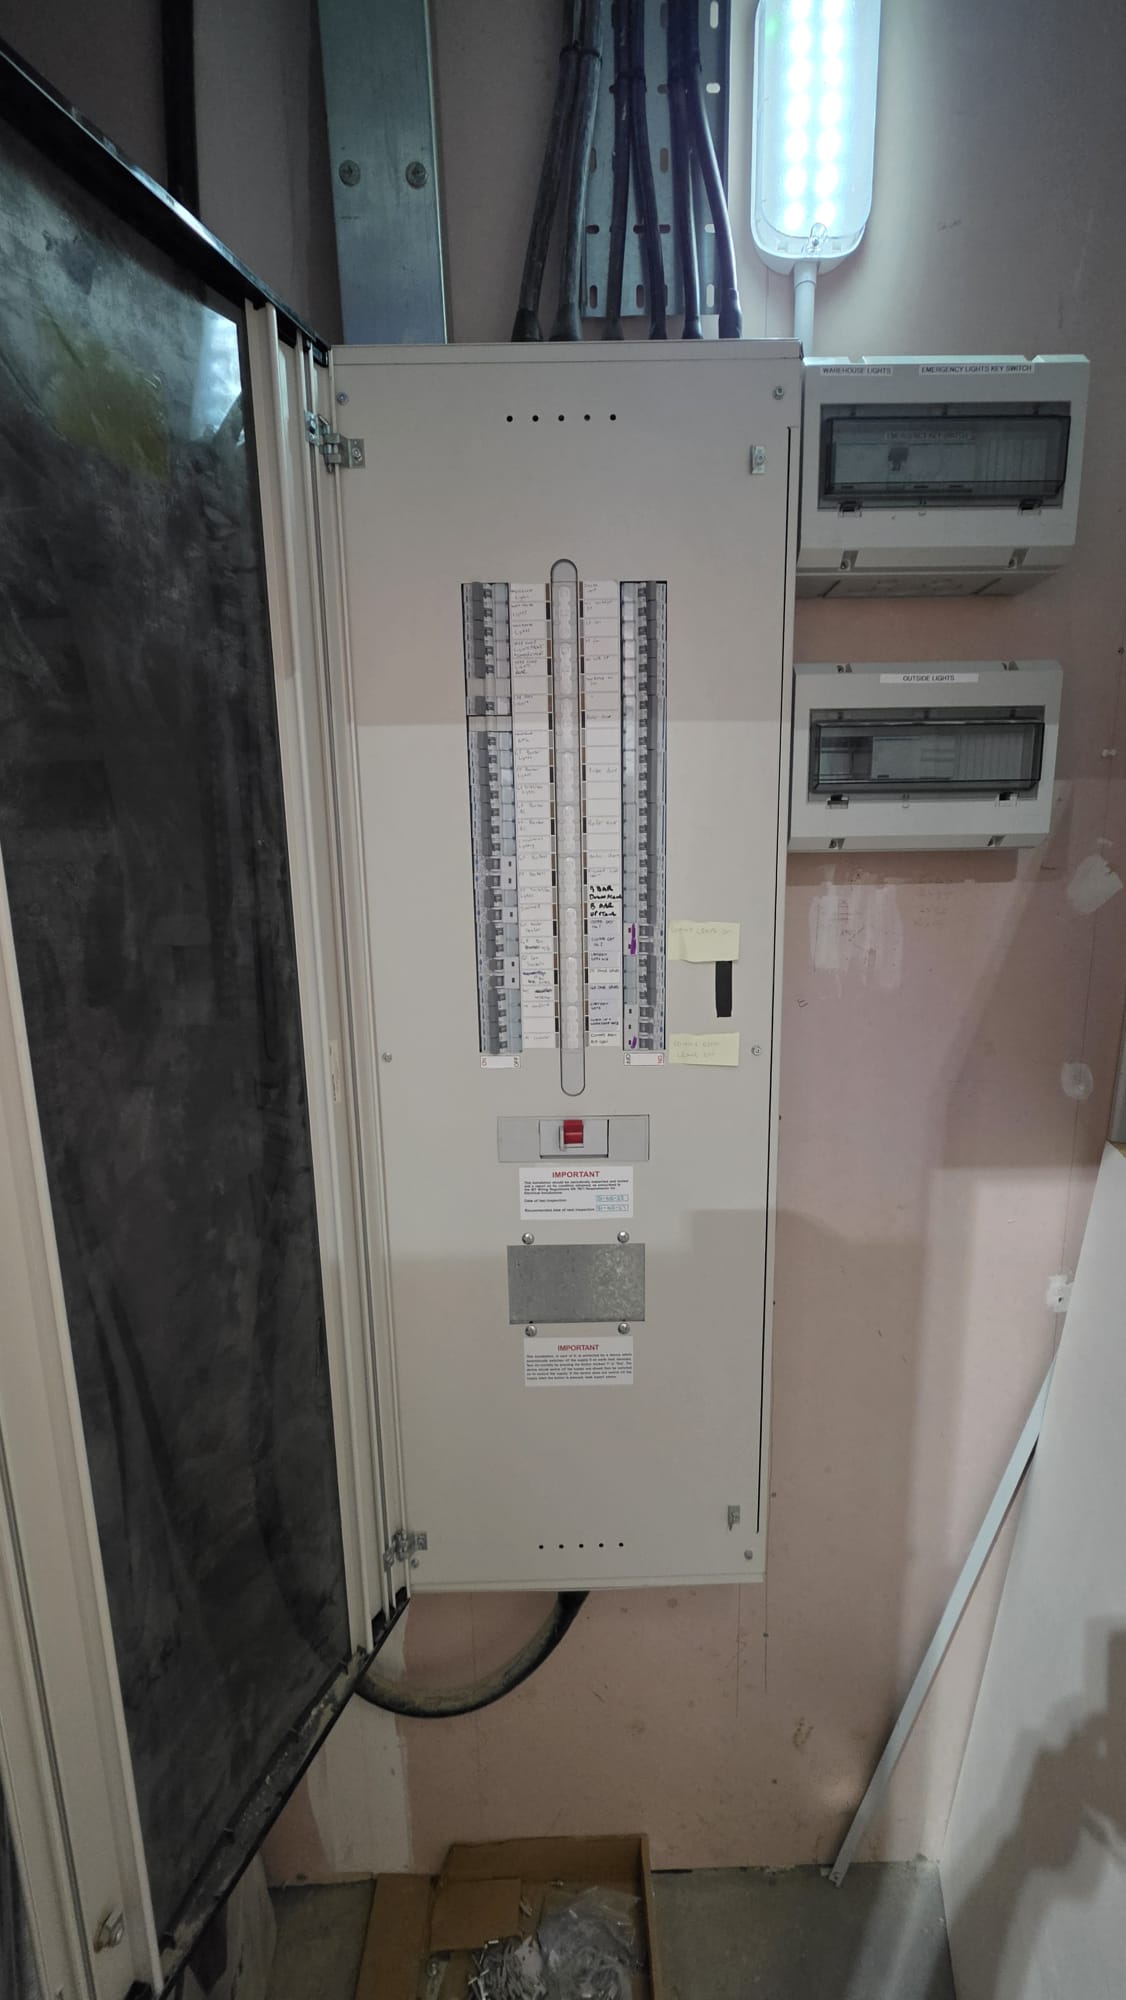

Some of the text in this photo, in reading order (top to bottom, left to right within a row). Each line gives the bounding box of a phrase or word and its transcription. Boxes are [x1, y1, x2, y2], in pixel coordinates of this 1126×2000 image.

[964, 365, 989, 373] LIGHTS
[1005, 364, 1032, 372] SWITCH
[552, 1170, 600, 1178] IMPORTANT
[557, 1344, 599, 1352] IMPORTANT
